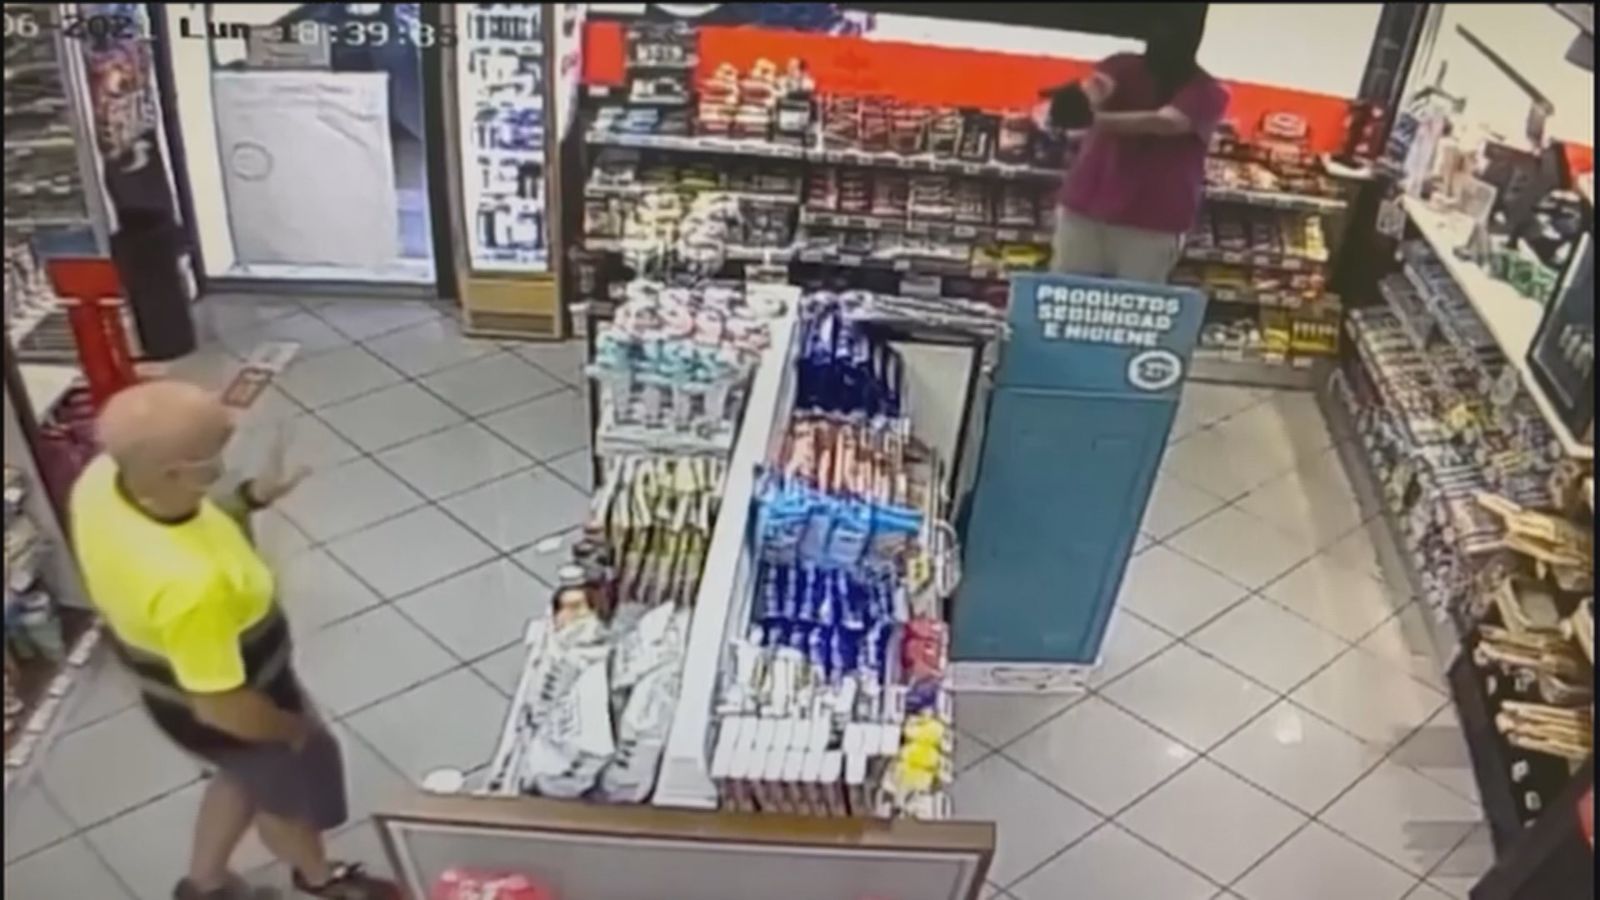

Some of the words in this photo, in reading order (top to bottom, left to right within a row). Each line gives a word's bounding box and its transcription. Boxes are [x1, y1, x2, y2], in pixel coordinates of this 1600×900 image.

[1037, 284, 1181, 315] PRODUCTOS
[1037, 303, 1172, 331] SEGURIDAD
[1043, 322, 1059, 339] E
[1064, 324, 1159, 347] HIGIENE
